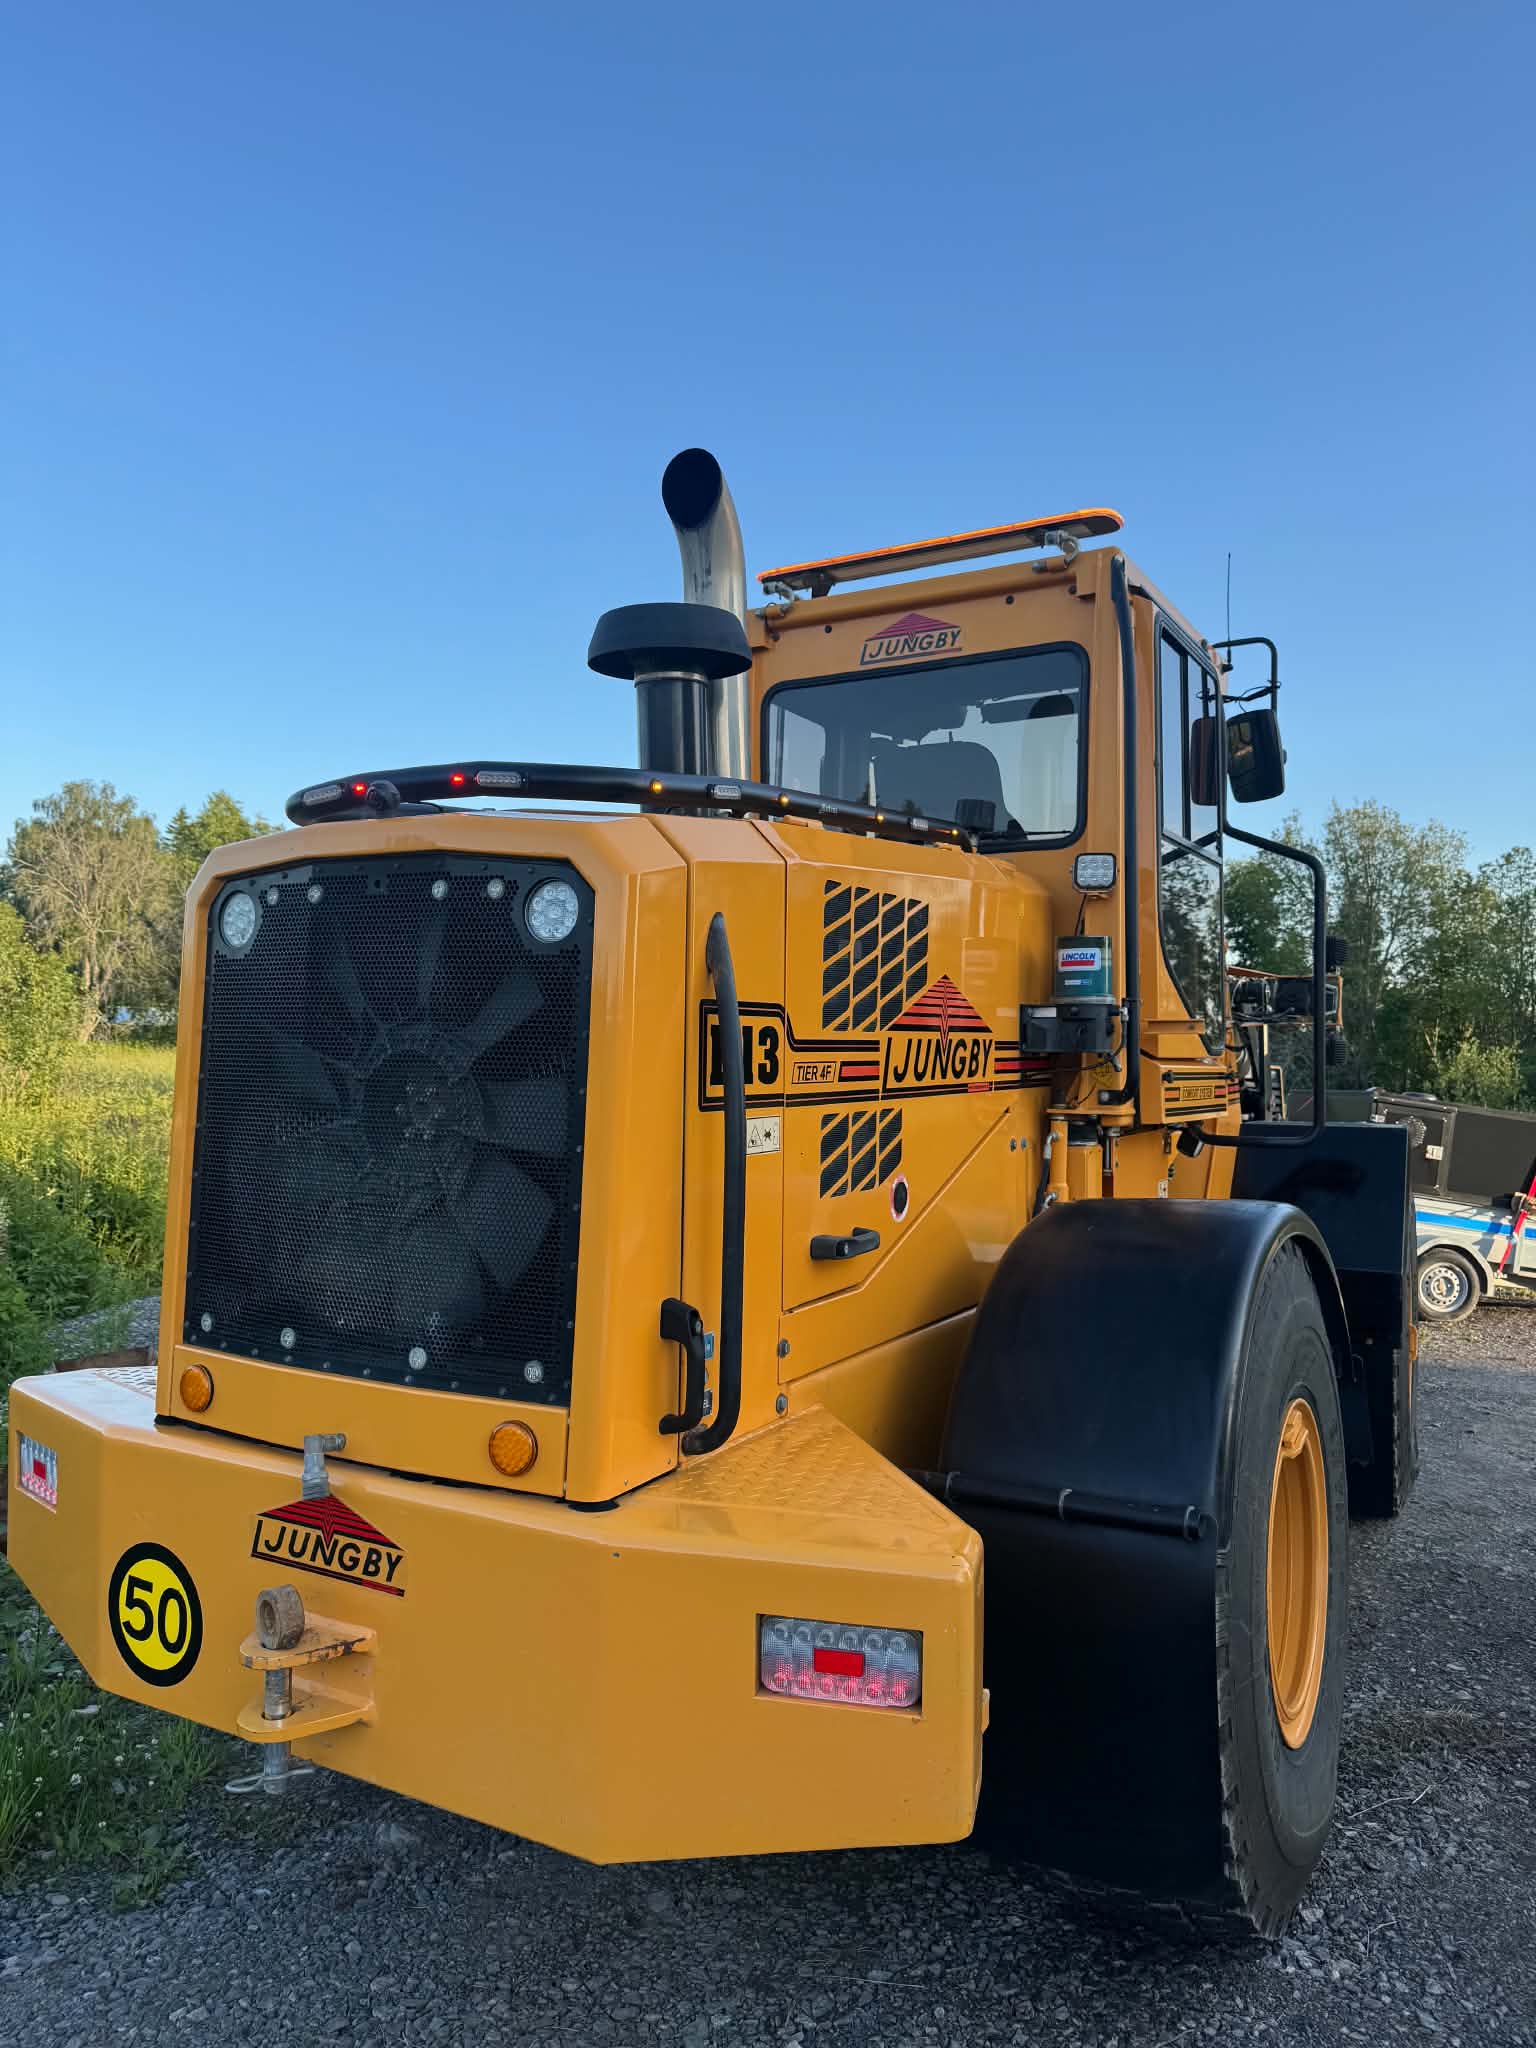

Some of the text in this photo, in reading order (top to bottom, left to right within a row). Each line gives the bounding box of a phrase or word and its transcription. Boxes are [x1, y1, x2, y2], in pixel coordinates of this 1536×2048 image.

[1062, 952, 1096, 960] LINCOLN
[796, 1064, 832, 1081] TIER 4F
[122, 1574, 188, 1654] 50
